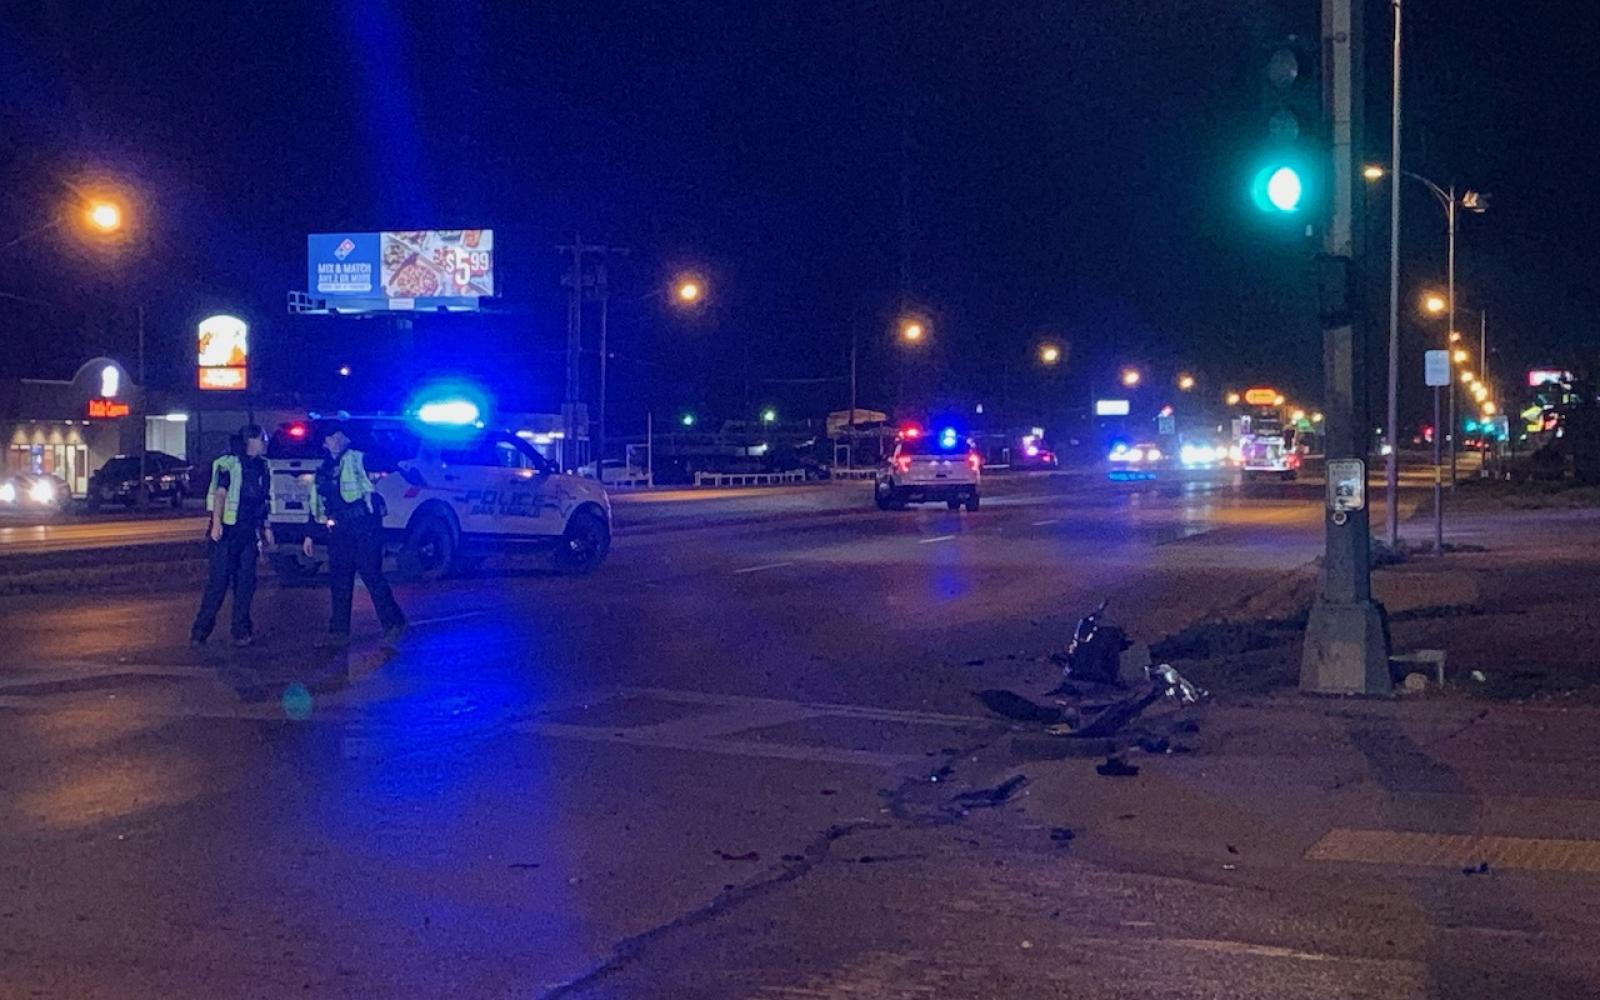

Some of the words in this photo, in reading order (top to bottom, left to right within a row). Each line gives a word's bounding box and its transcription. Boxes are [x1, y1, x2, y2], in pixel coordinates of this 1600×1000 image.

[318, 263, 334, 273] MIX
[343, 263, 371, 273] MATCH
[464, 490, 548, 506] POLICE
